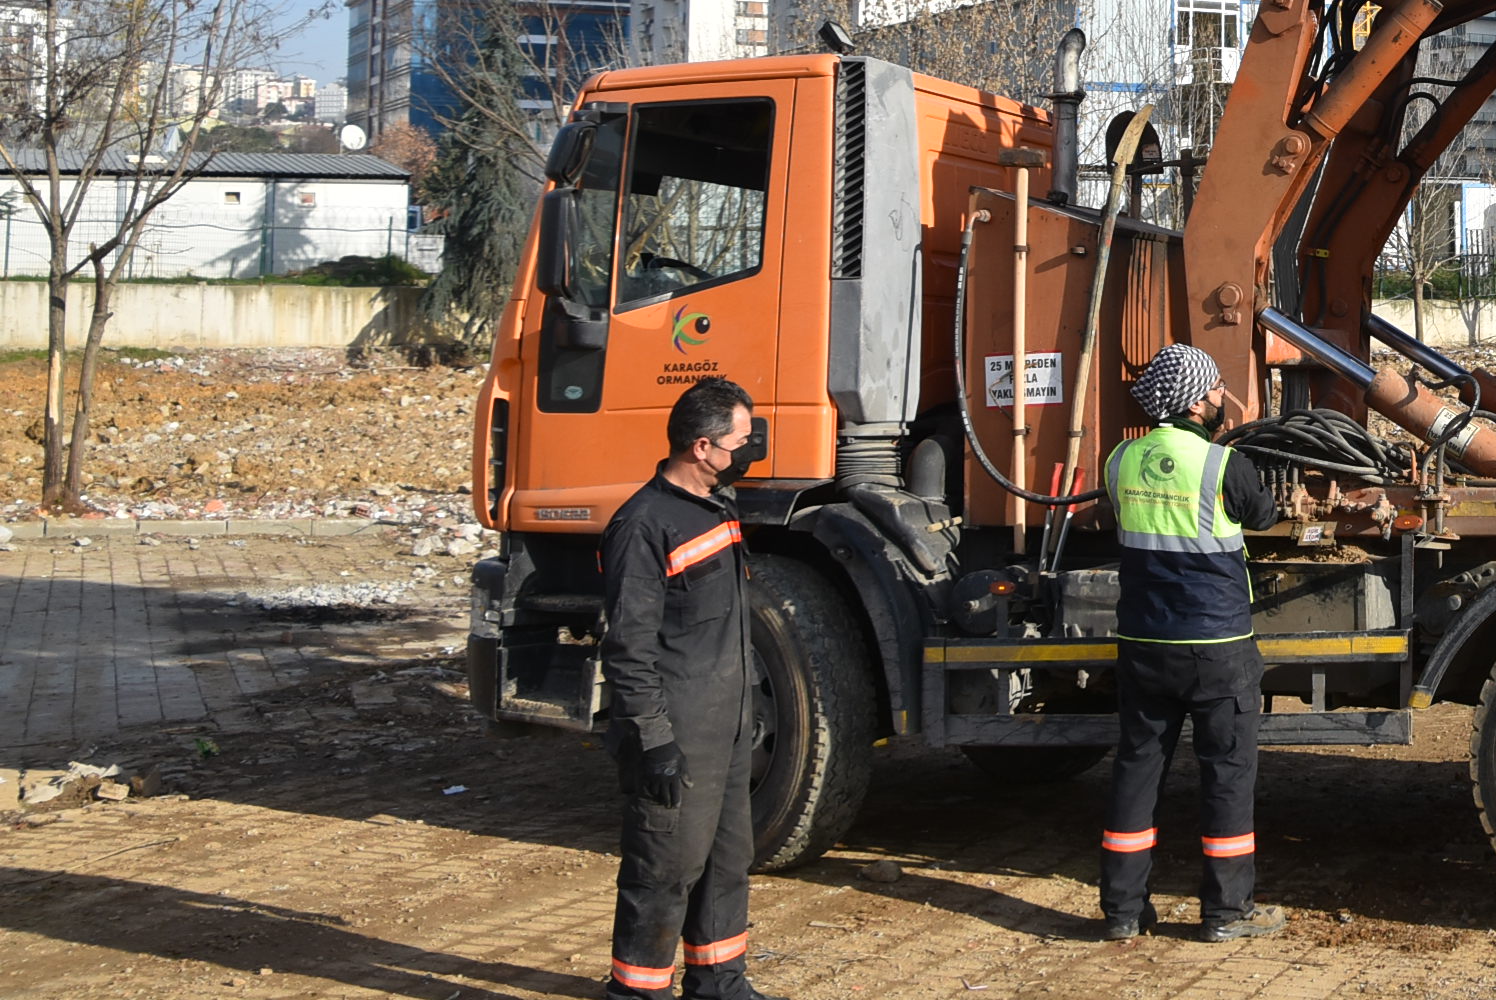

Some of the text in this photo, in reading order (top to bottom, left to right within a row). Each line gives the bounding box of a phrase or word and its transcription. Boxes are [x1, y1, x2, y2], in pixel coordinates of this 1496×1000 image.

[663, 359, 719, 373] KARAGÖZ
[990, 358, 1057, 372] 25 MREDEN
[1009, 373, 1038, 384] FLA
[991, 386, 1057, 400] YAKLMAYIN
